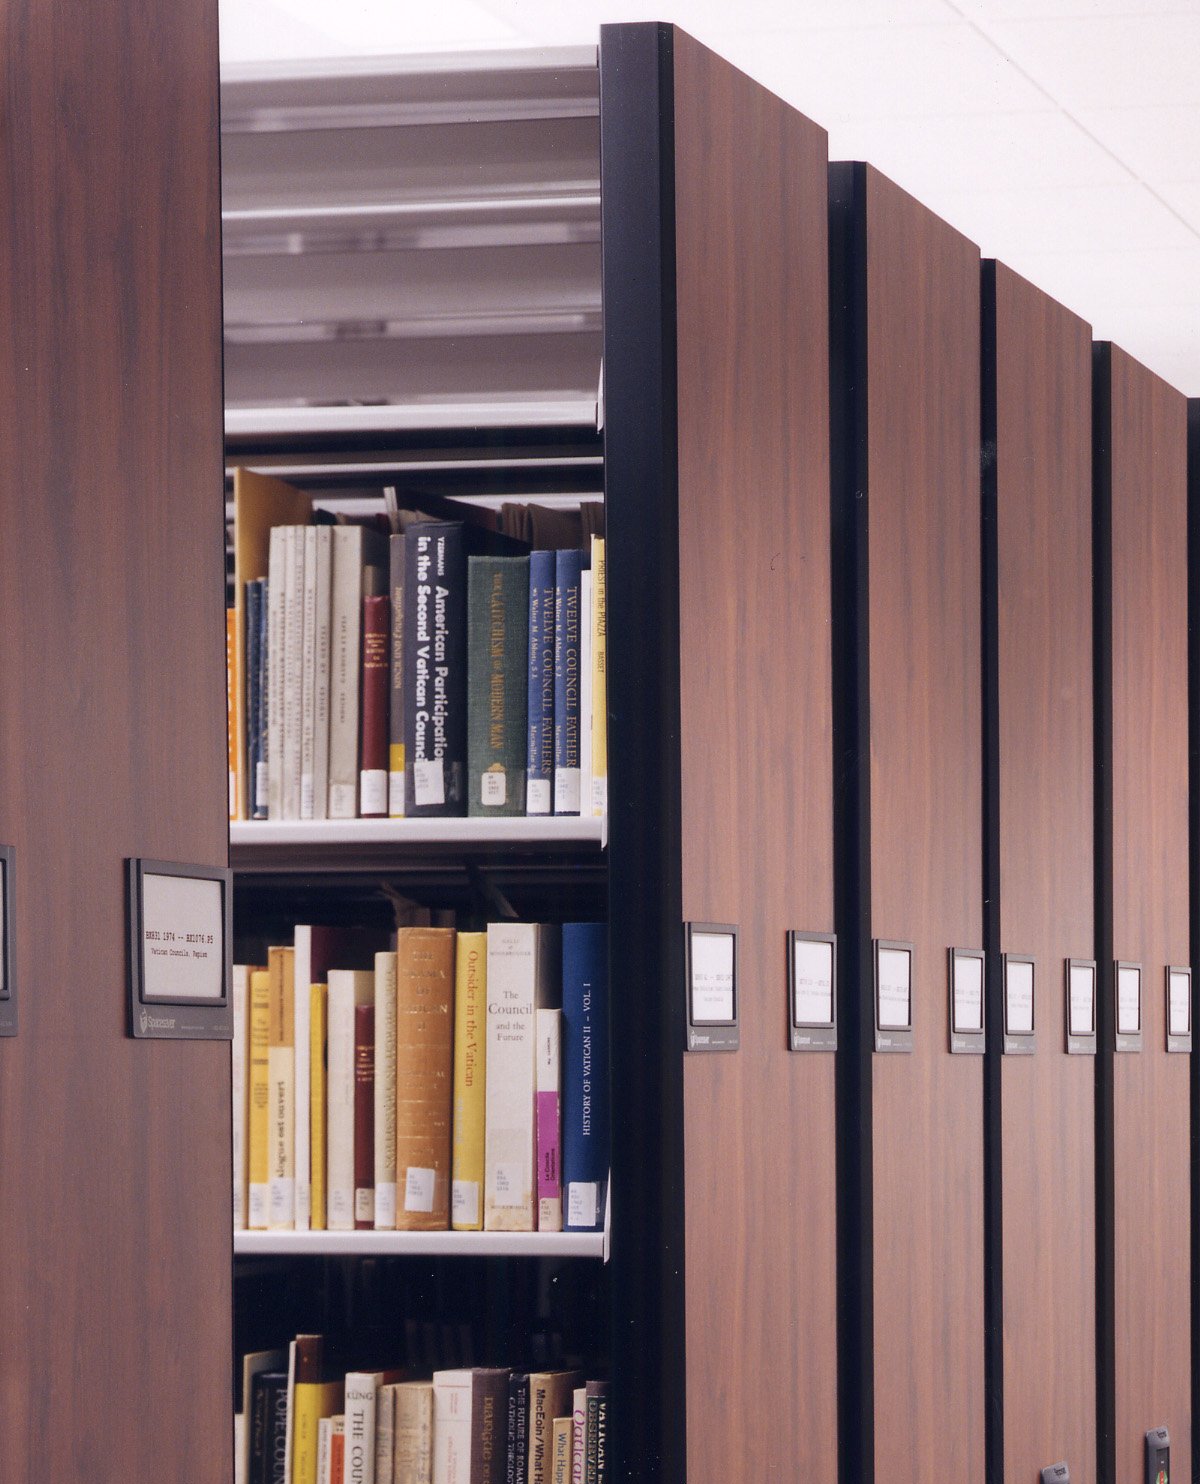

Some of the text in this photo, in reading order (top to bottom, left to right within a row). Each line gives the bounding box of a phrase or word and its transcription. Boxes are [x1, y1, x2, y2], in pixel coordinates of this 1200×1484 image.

[434, 585, 449, 662] American
[415, 536, 431, 762] in the Second Vatican Counci
[541, 587, 554, 774] TWELVE COUNCIL FATHERS
[566, 586, 577, 768] TWELVE COUNCIL FATHER
[503, 990, 519, 1000] The
[583, 990, 591, 1012] VOL.
[464, 950, 478, 1087] Outsider in the Vatican
[488, 1003, 533, 1015] Council
[496, 1021, 526, 1030] and the
[497, 1033, 524, 1041] Future
[583, 1026, 591, 1034] II
[583, 1036, 591, 1077] VATICAN
[583, 1079, 591, 1092] OF
[583, 1094, 591, 1136] HISTORY
[517, 1388, 525, 1405] THE
[352, 1411, 364, 1439] THE
[507, 1396, 516, 1441] CATHOLIC
[517, 1407, 525, 1439] FUTURE
[516, 1441, 525, 1453] OF
[557, 1432, 567, 1457] What
